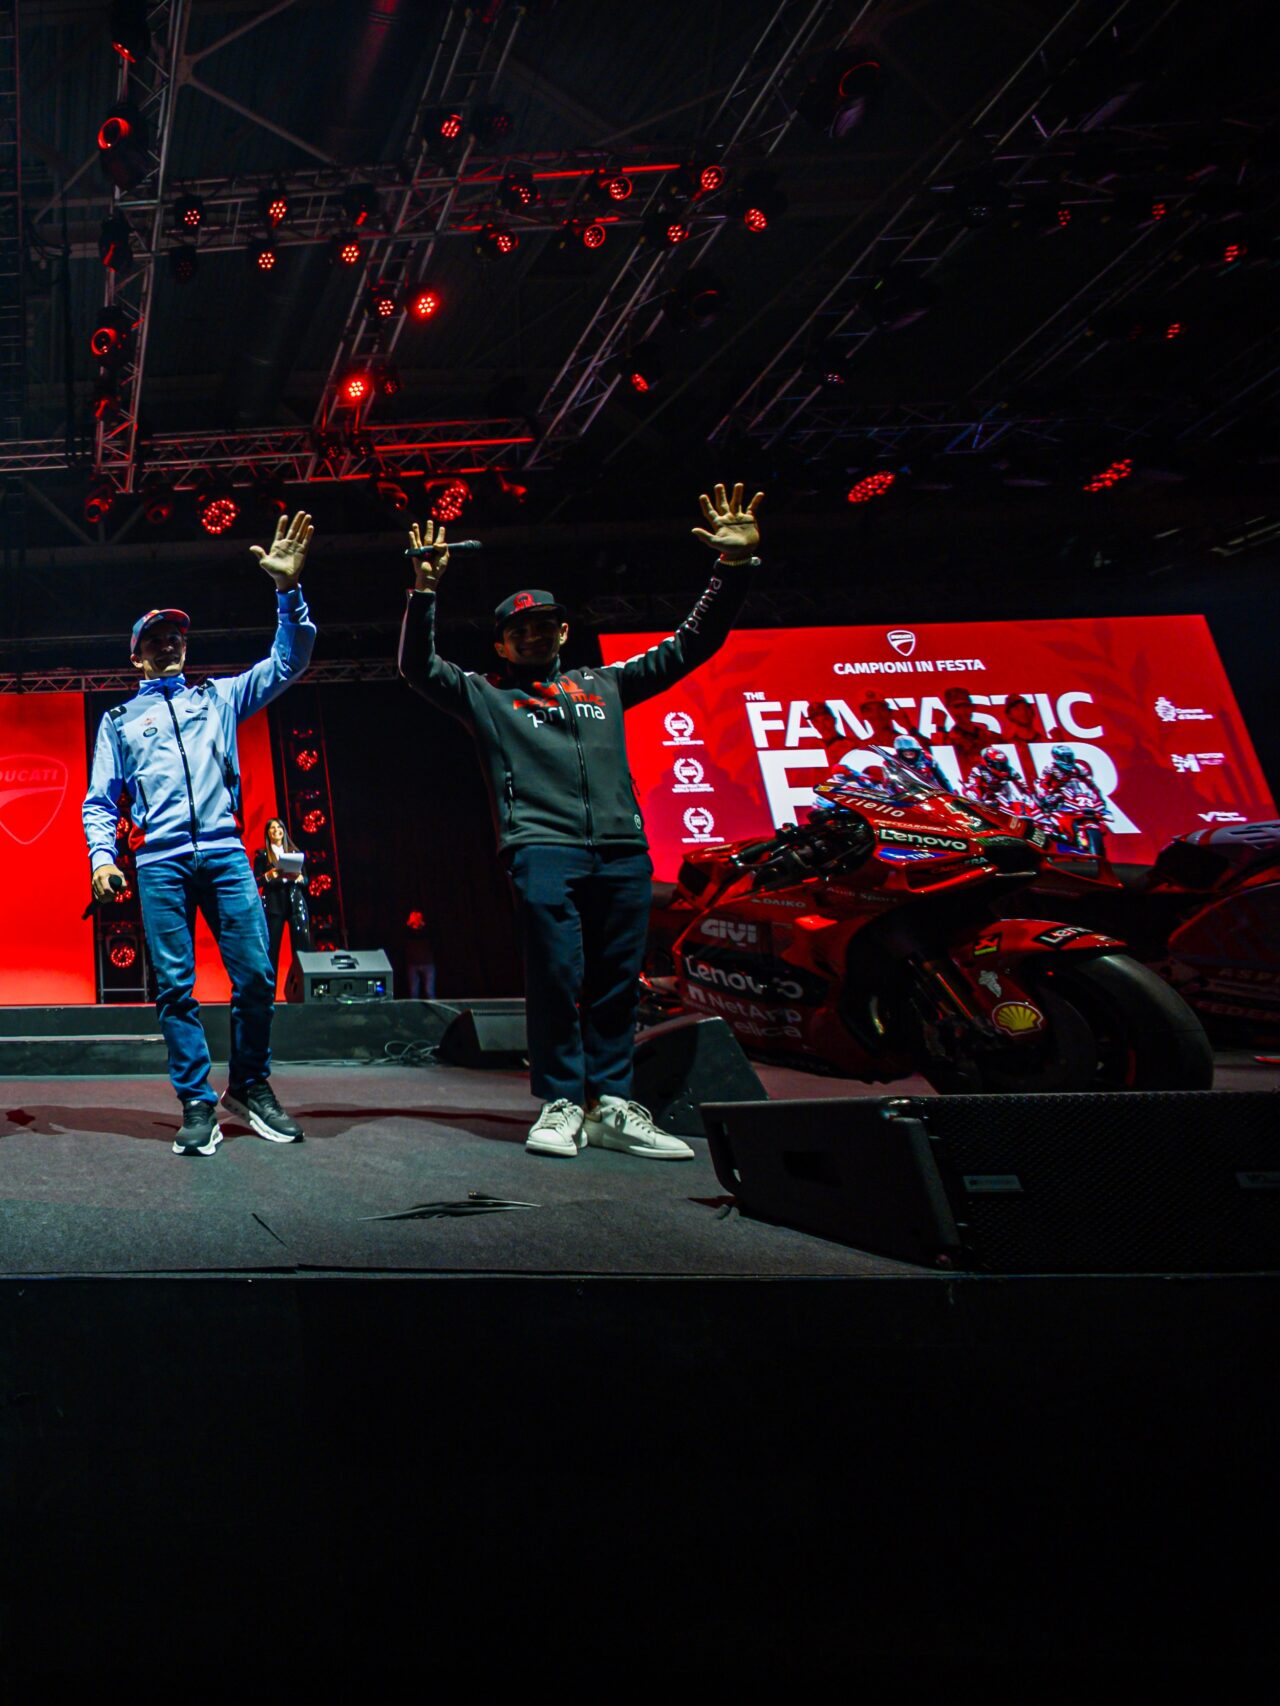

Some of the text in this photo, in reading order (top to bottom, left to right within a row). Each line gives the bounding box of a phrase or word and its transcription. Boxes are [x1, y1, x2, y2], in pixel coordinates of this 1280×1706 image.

[684, 575, 723, 635] prima
[833, 659, 985, 675] CAMPIONI IN FESTA
[744, 692, 765, 701] THE
[845, 796, 906, 818] riello
[879, 828, 967, 850] Lenovo
[699, 917, 757, 945] GIVI
[684, 953, 805, 1000] Lenovo
